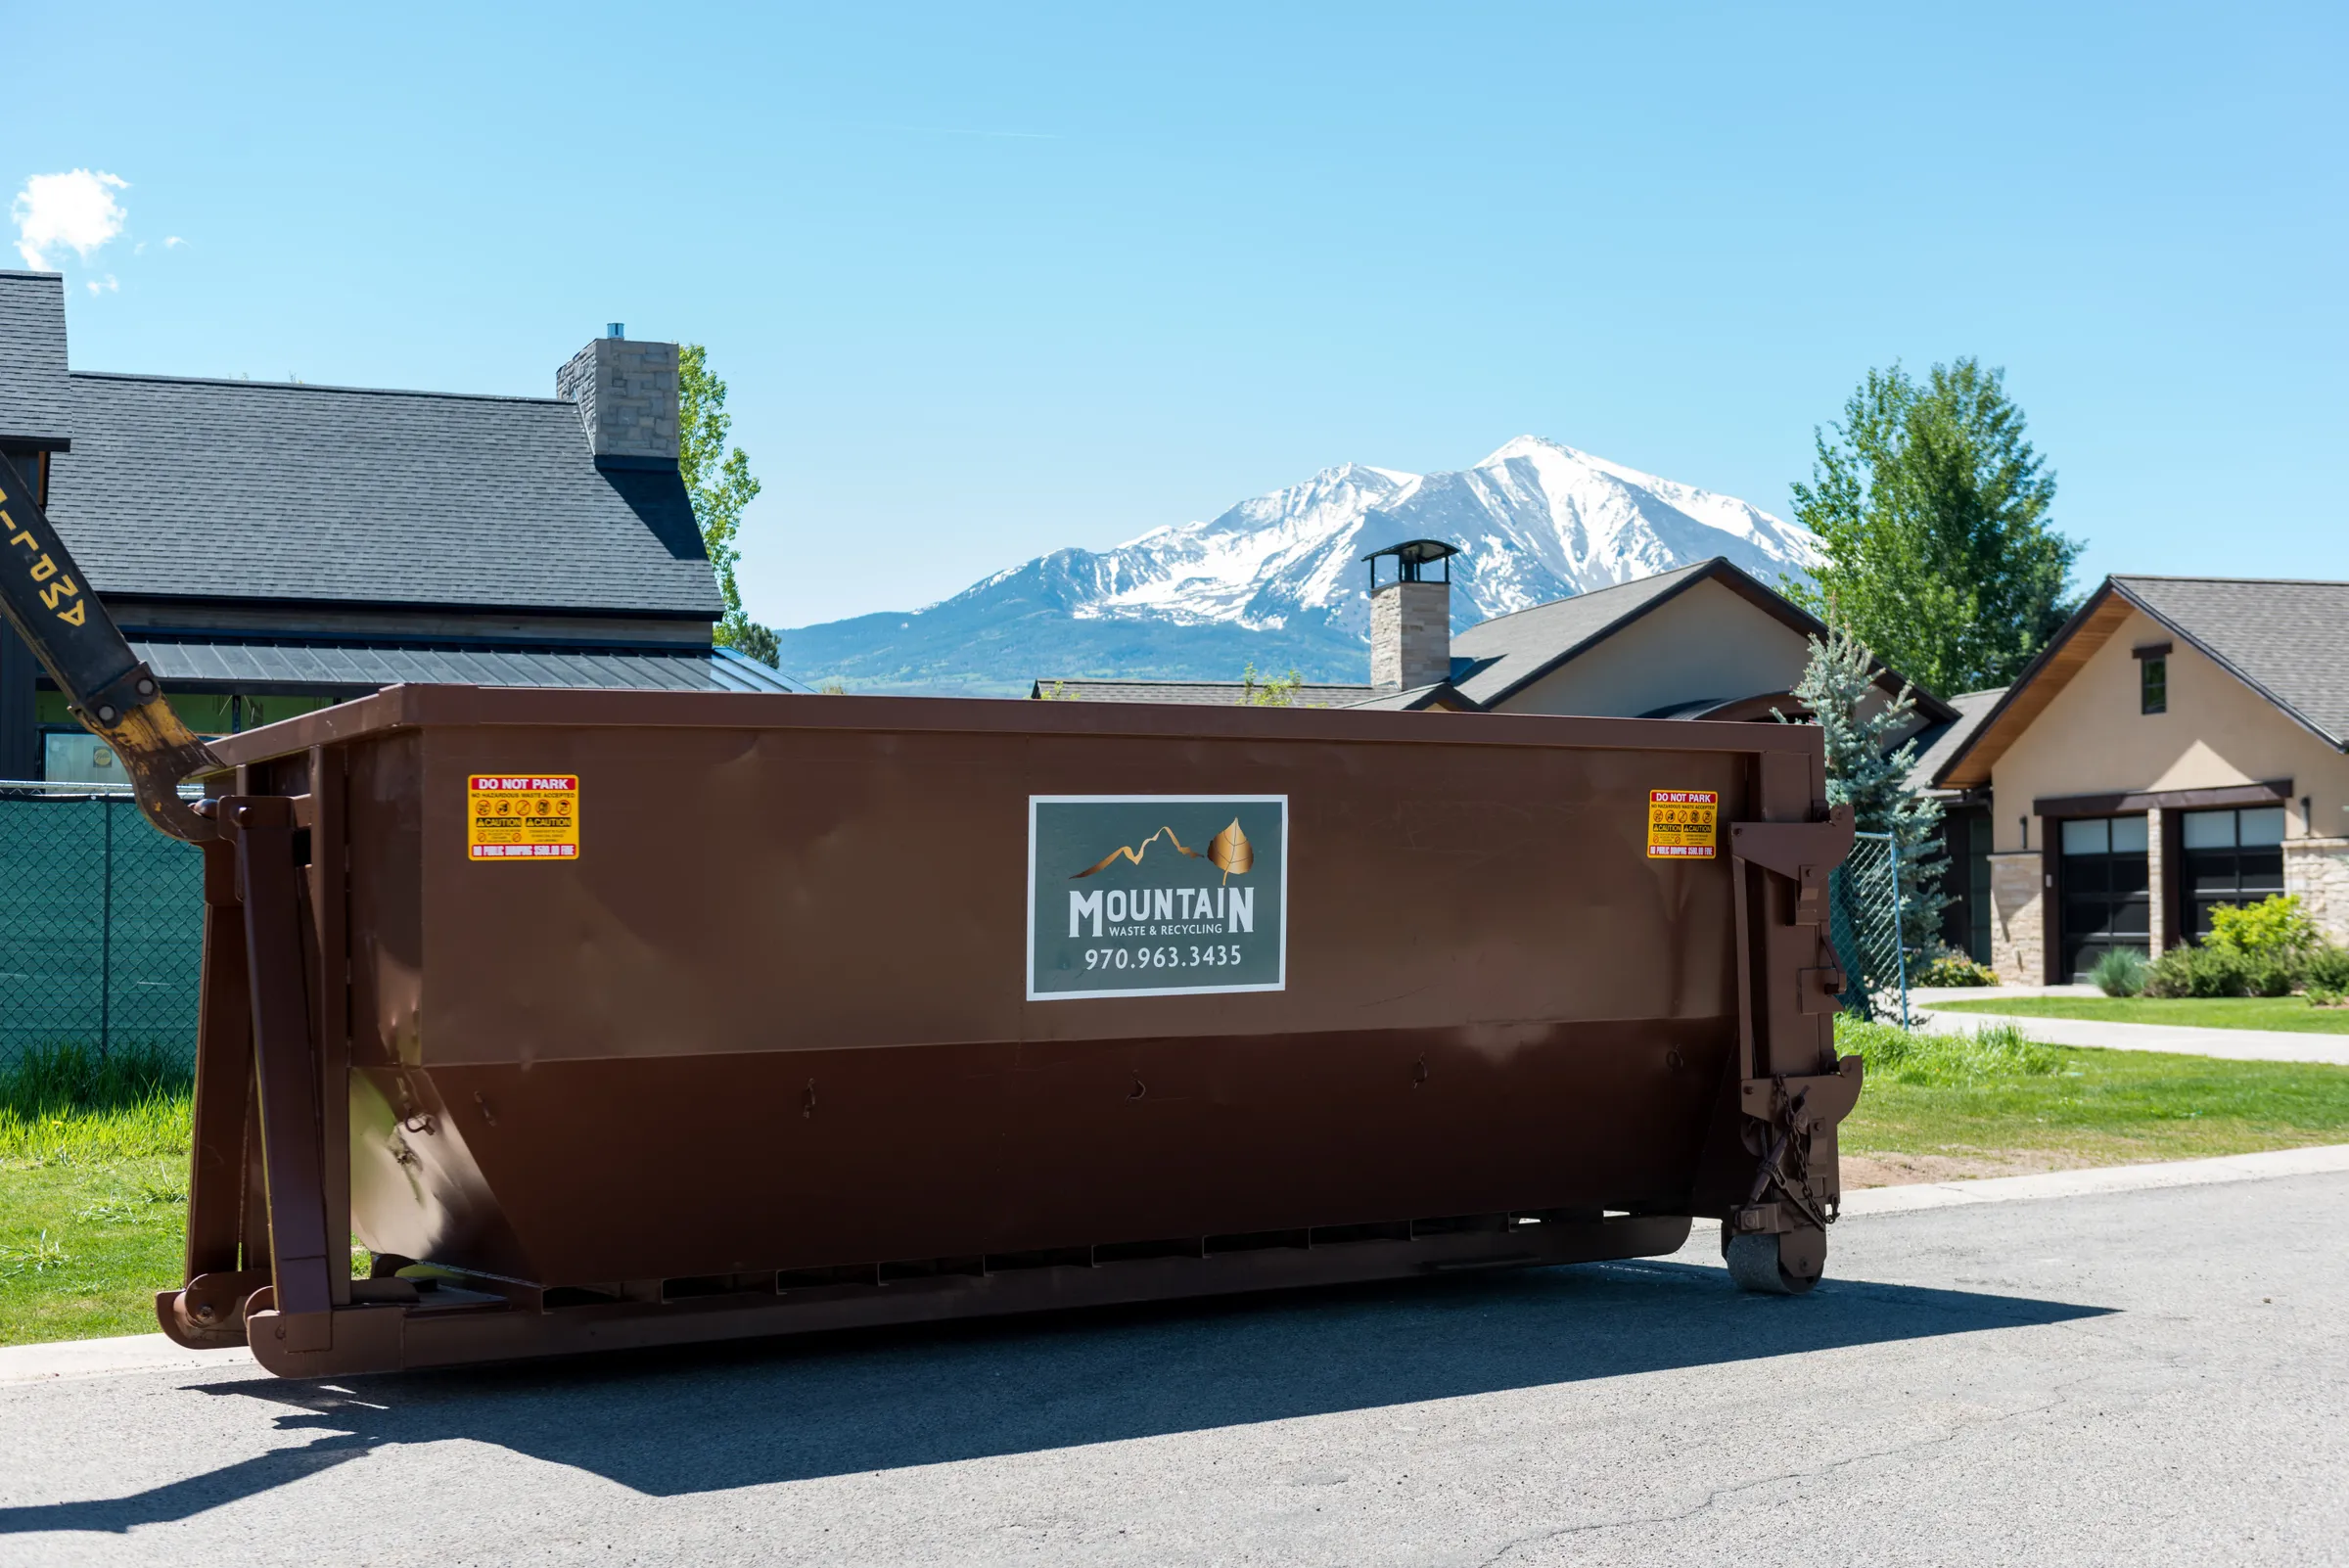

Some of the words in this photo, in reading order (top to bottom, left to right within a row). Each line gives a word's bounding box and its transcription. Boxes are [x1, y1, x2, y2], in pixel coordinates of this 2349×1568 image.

[0, 487, 86, 627] AMPLI
[478, 778, 499, 789] DO
[502, 778, 529, 789] NOT
[532, 778, 568, 789] PARK
[1656, 793, 1668, 801] DO
[1670, 793, 1687, 802] NOT
[1689, 794, 1711, 803] PARK
[484, 818, 521, 826] CAUTION
[534, 818, 571, 826] CAUTION
[1068, 887, 1255, 938] MOUNTAIN
[1109, 926, 1146, 936] WASTE
[1149, 925, 1157, 935] &
[1161, 923, 1222, 935] RECYCLING
[1084, 945, 1242, 970] 970.963.3435
